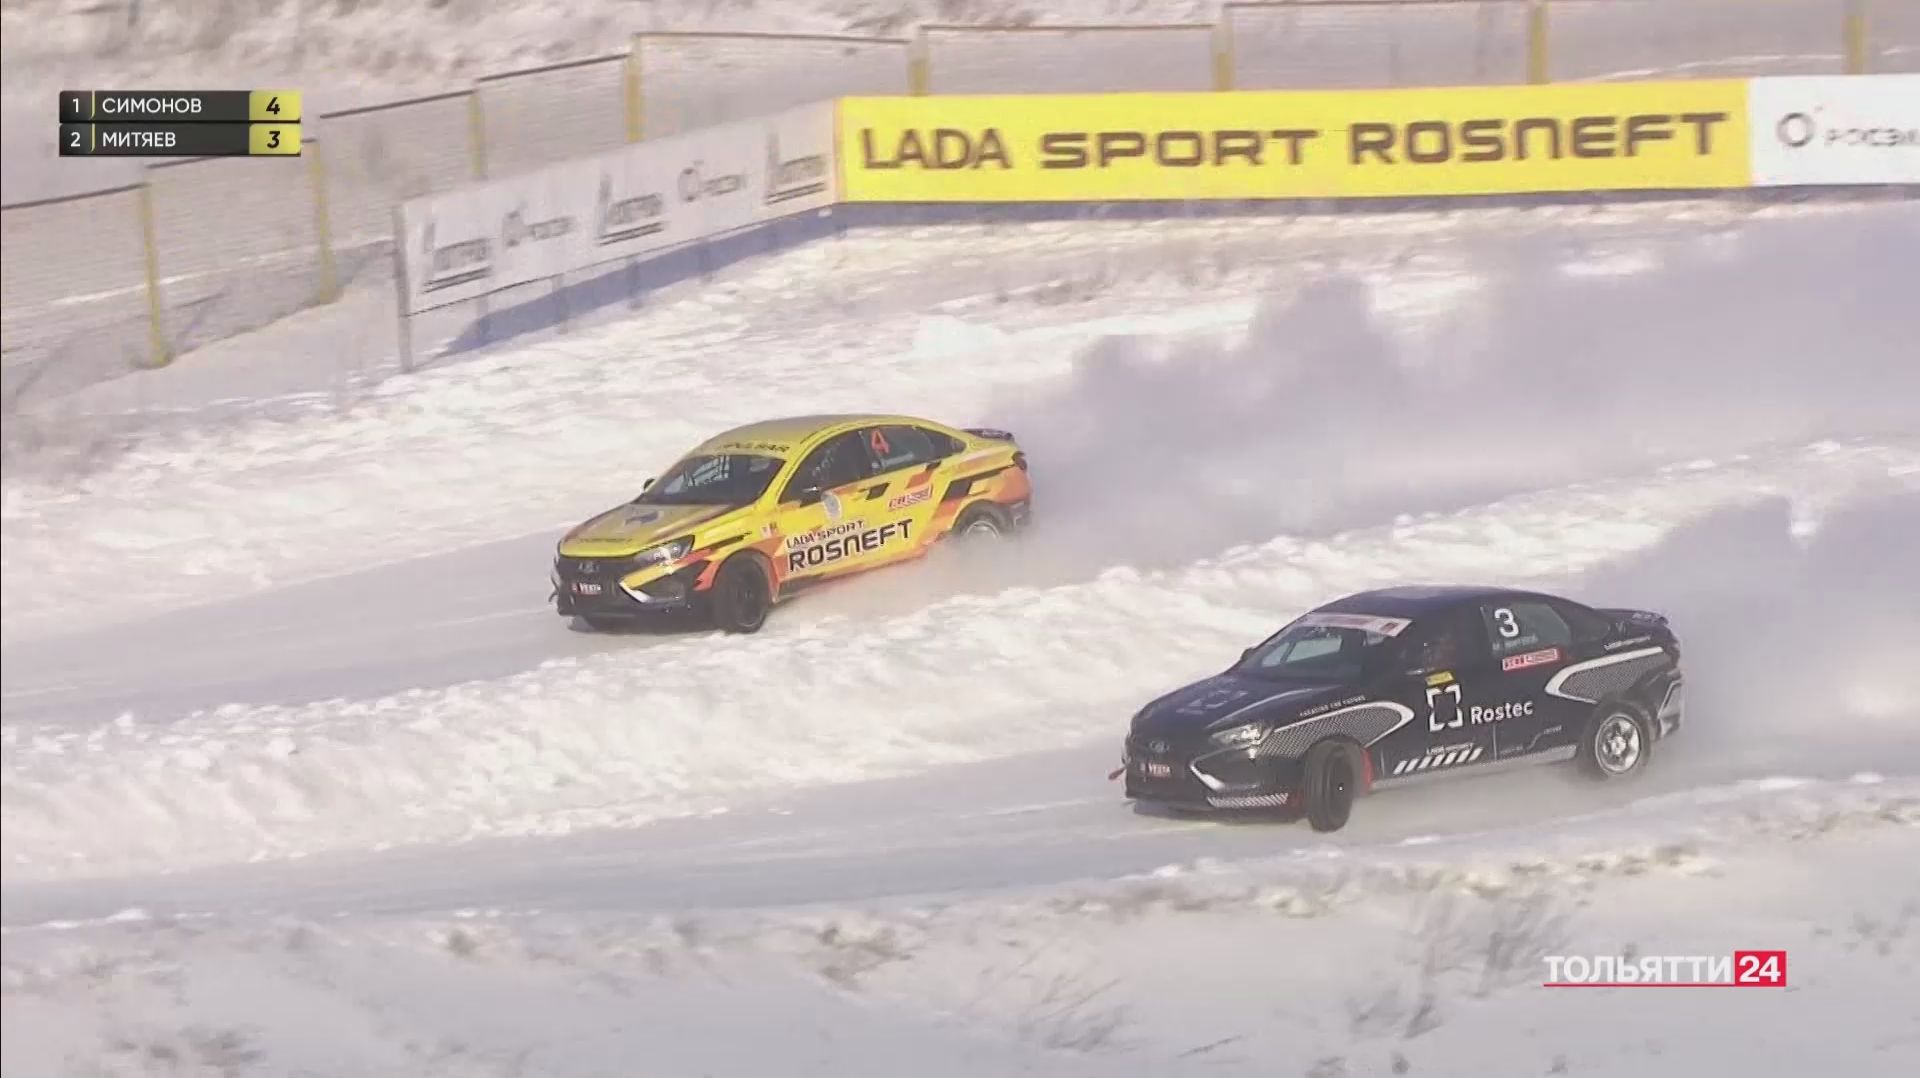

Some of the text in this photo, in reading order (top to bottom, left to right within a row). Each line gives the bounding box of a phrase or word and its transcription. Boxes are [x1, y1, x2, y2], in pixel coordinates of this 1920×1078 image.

[860, 127, 1014, 170] LADA
[1040, 128, 1320, 169] SPORT
[1348, 111, 1731, 166] ROSNEFT
[870, 430, 890, 454] 4
[786, 520, 865, 549] LADA SPORT
[788, 518, 913, 572] ROSNEFT
[1494, 608, 1519, 637] 3
[1470, 700, 1534, 725] Rostec
